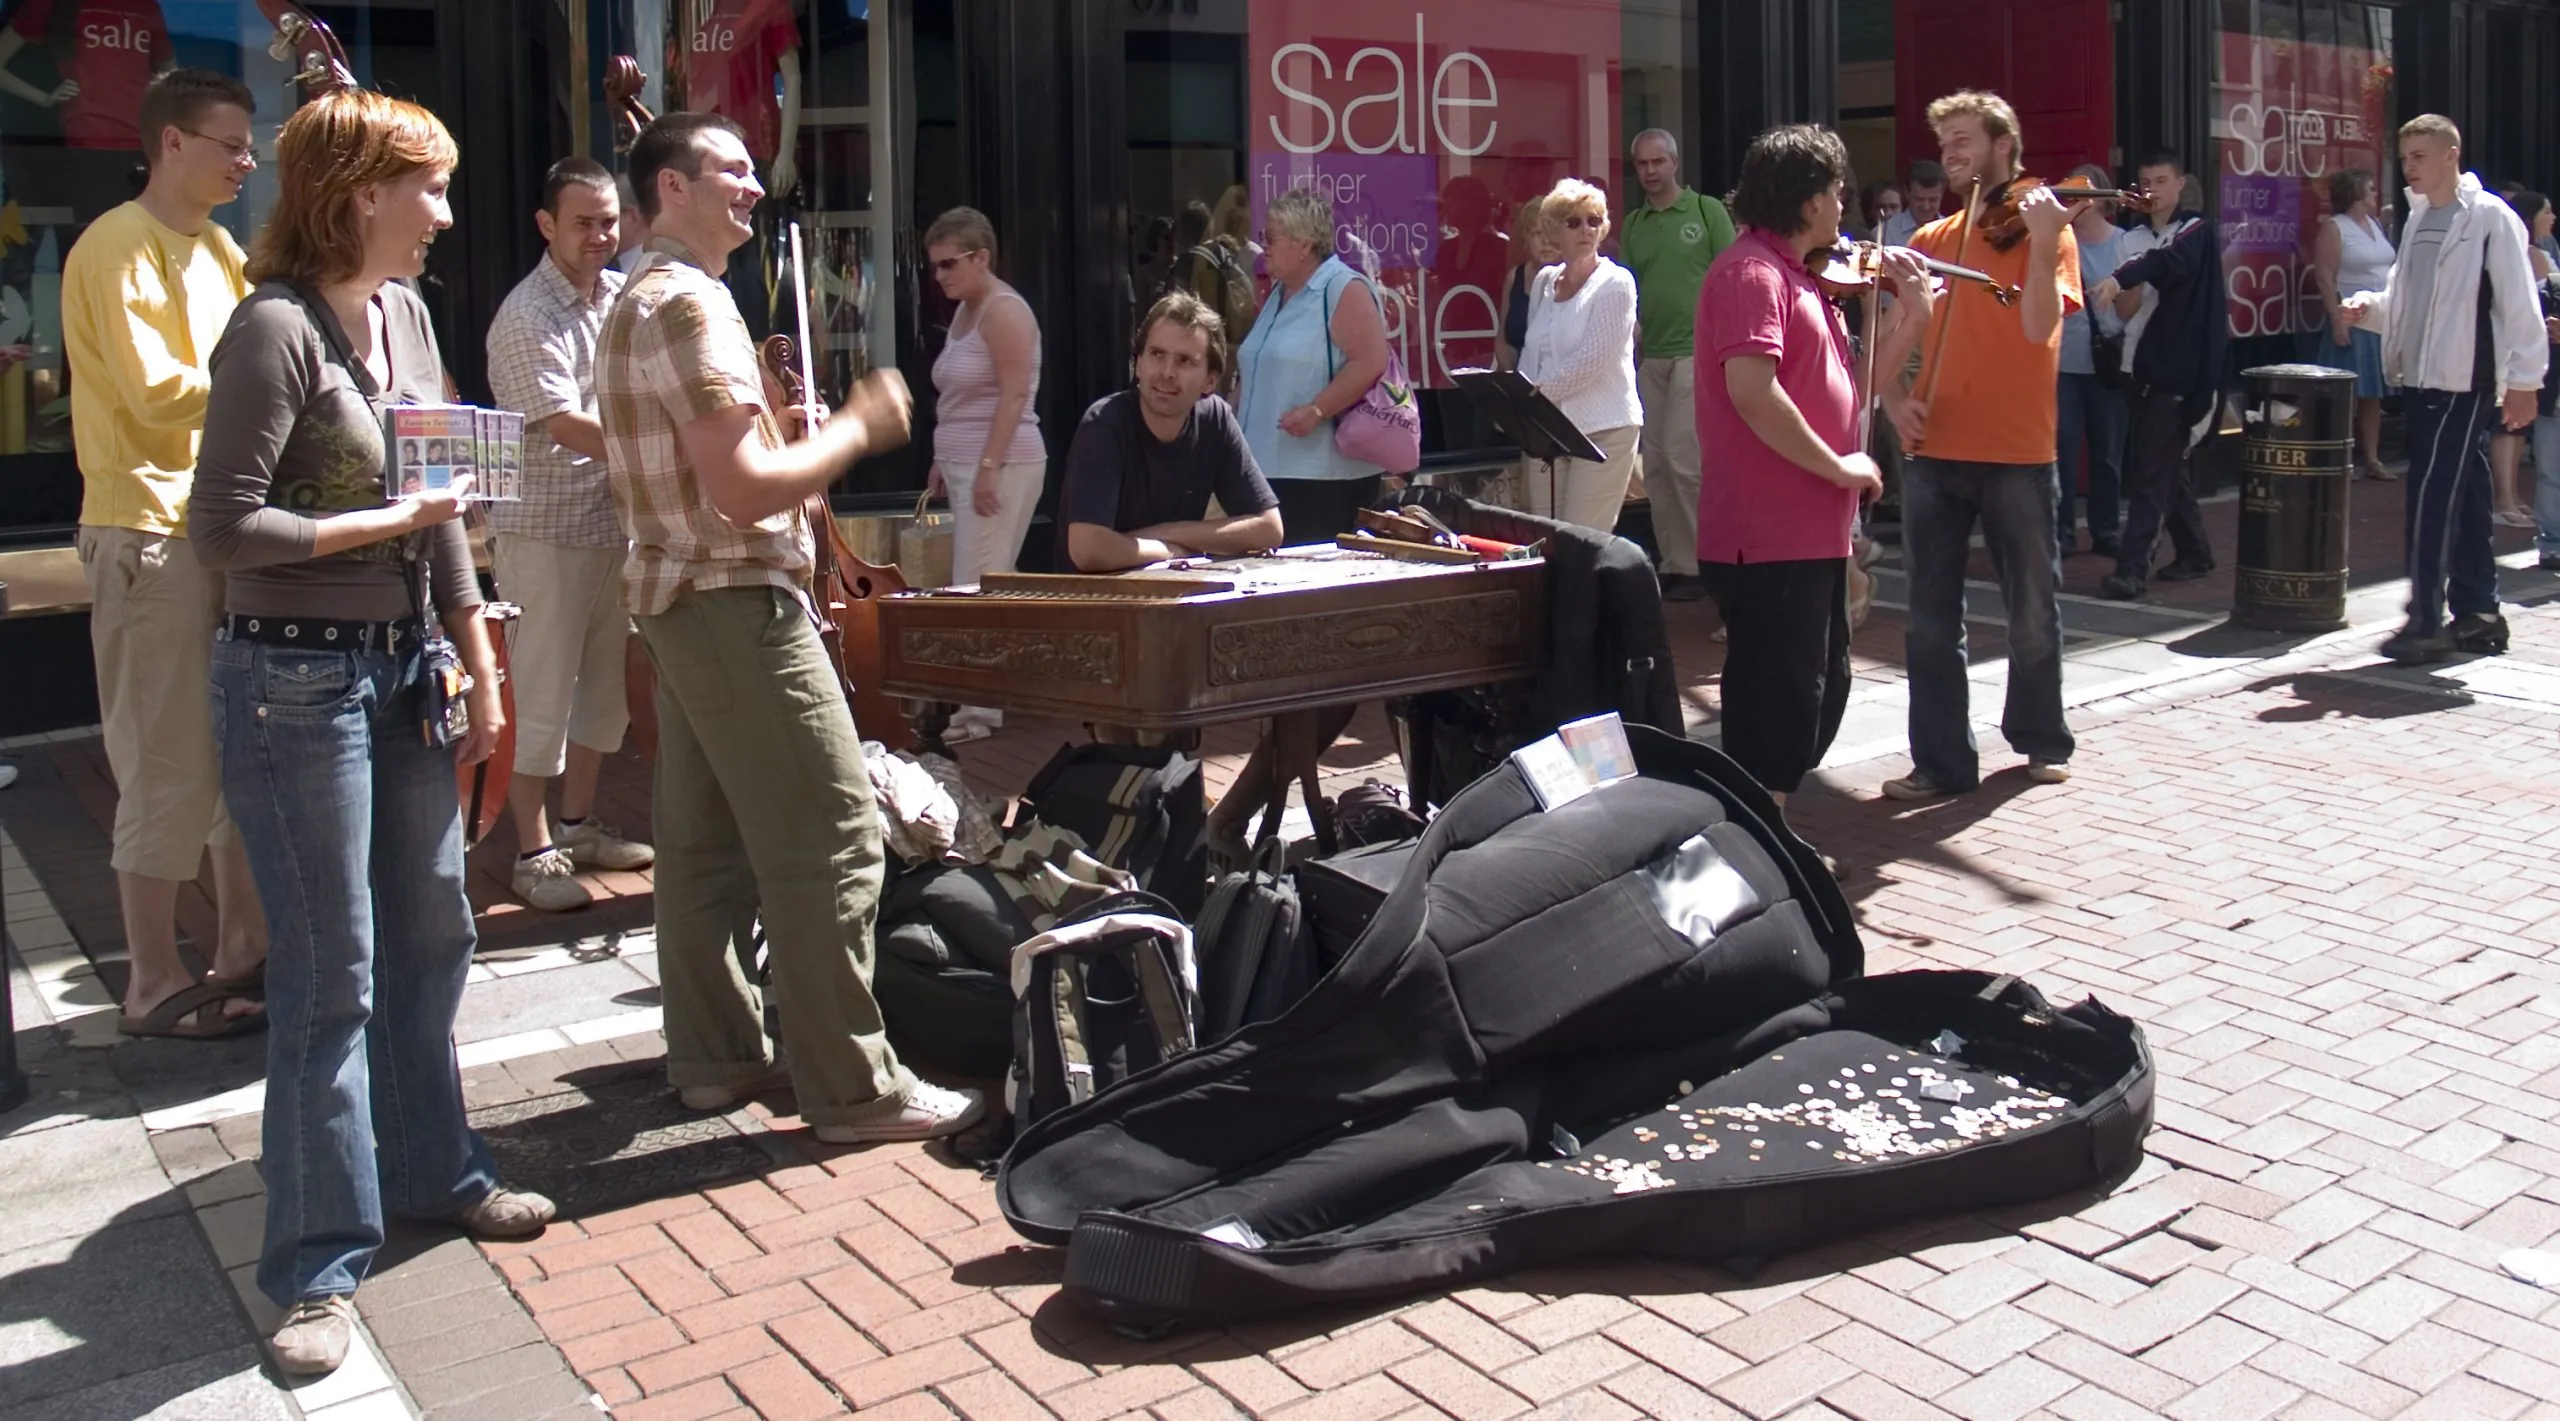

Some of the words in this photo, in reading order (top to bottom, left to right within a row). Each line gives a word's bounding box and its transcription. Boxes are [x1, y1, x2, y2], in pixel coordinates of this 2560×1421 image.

[84, 19, 151, 53] sale
[692, 23, 734, 52] ale
[1268, 13, 1498, 155] sale
[2228, 82, 2326, 178] sale
[1261, 163, 1367, 203] further
[2224, 181, 2271, 209] further
[1334, 214, 1428, 254] ctions
[2228, 252, 2325, 337] sale
[1378, 268, 1499, 388] ale
